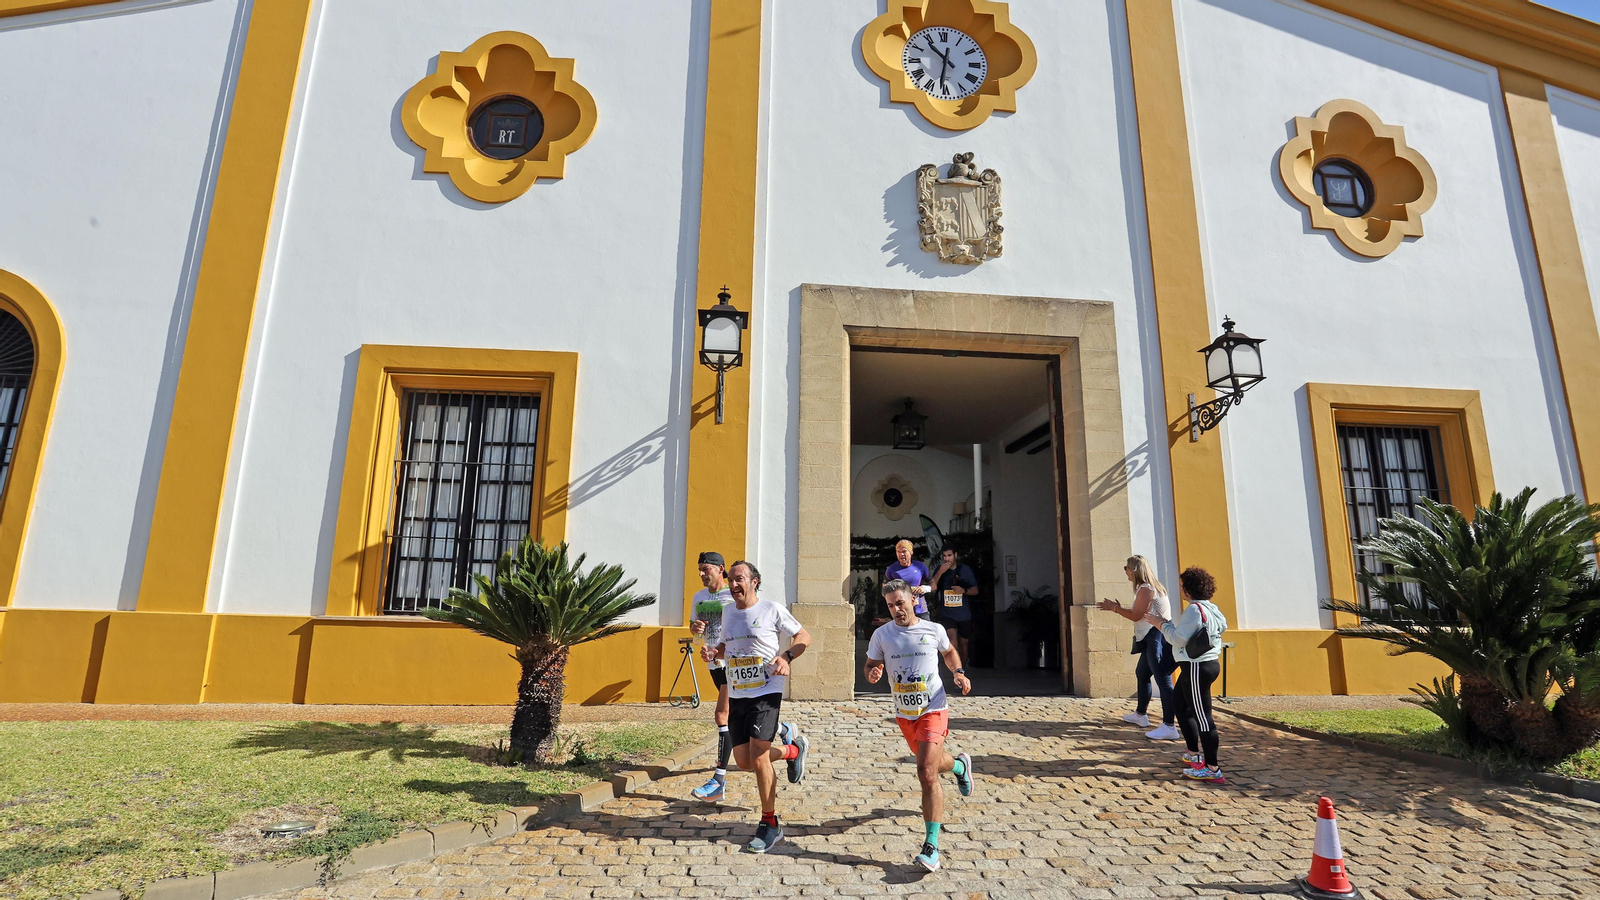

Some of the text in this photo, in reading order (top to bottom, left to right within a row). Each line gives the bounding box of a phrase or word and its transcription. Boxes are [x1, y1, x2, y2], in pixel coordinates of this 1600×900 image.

[938, 31, 949, 43] XII
[498, 129, 516, 144] RT
[734, 666, 760, 680] 1652
[898, 693, 923, 706] 1686
